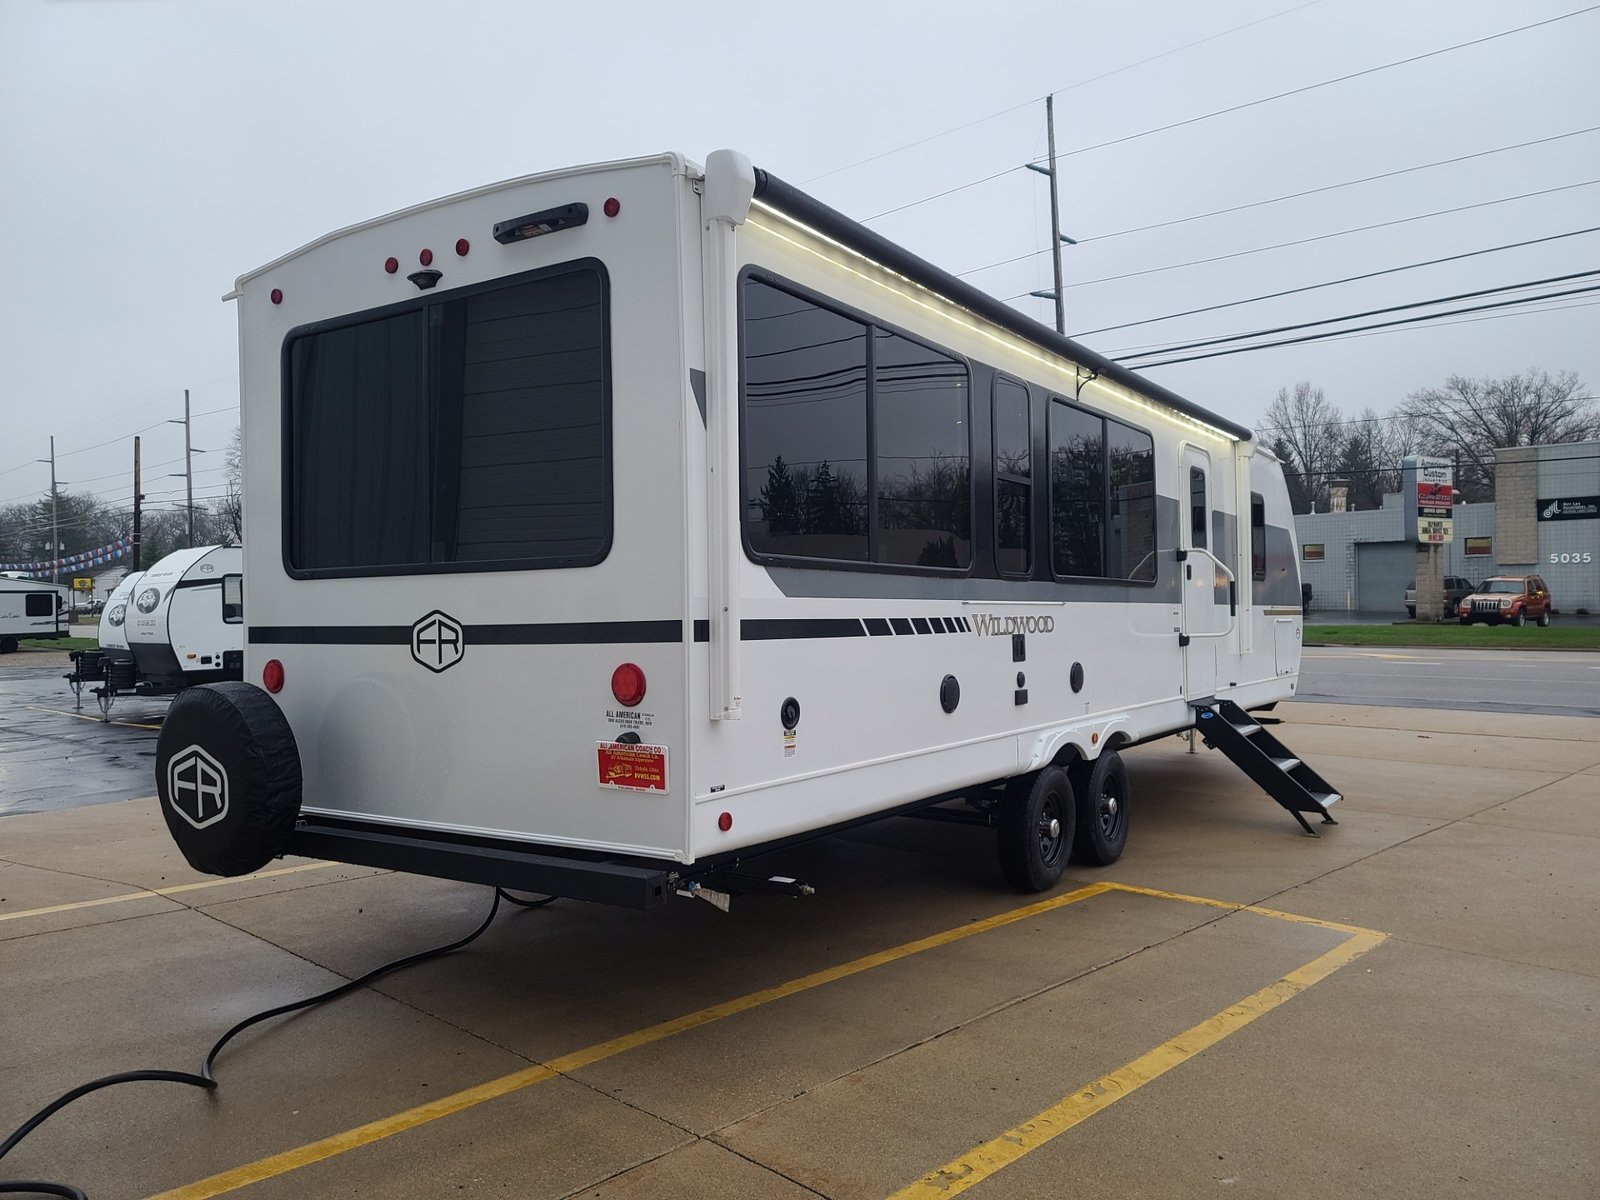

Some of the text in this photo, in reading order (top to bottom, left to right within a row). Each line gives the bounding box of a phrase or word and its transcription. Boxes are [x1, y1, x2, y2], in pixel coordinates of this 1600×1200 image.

[1550, 552, 1592, 564] 5035
[971, 614, 1055, 637] WILDWOOD
[606, 710, 615, 718] ALL
[615, 710, 641, 720] AMERICAN
[609, 743, 635, 751] AMERICAN
[635, 745, 653, 753] COACH
[653, 746, 662, 754] CO
